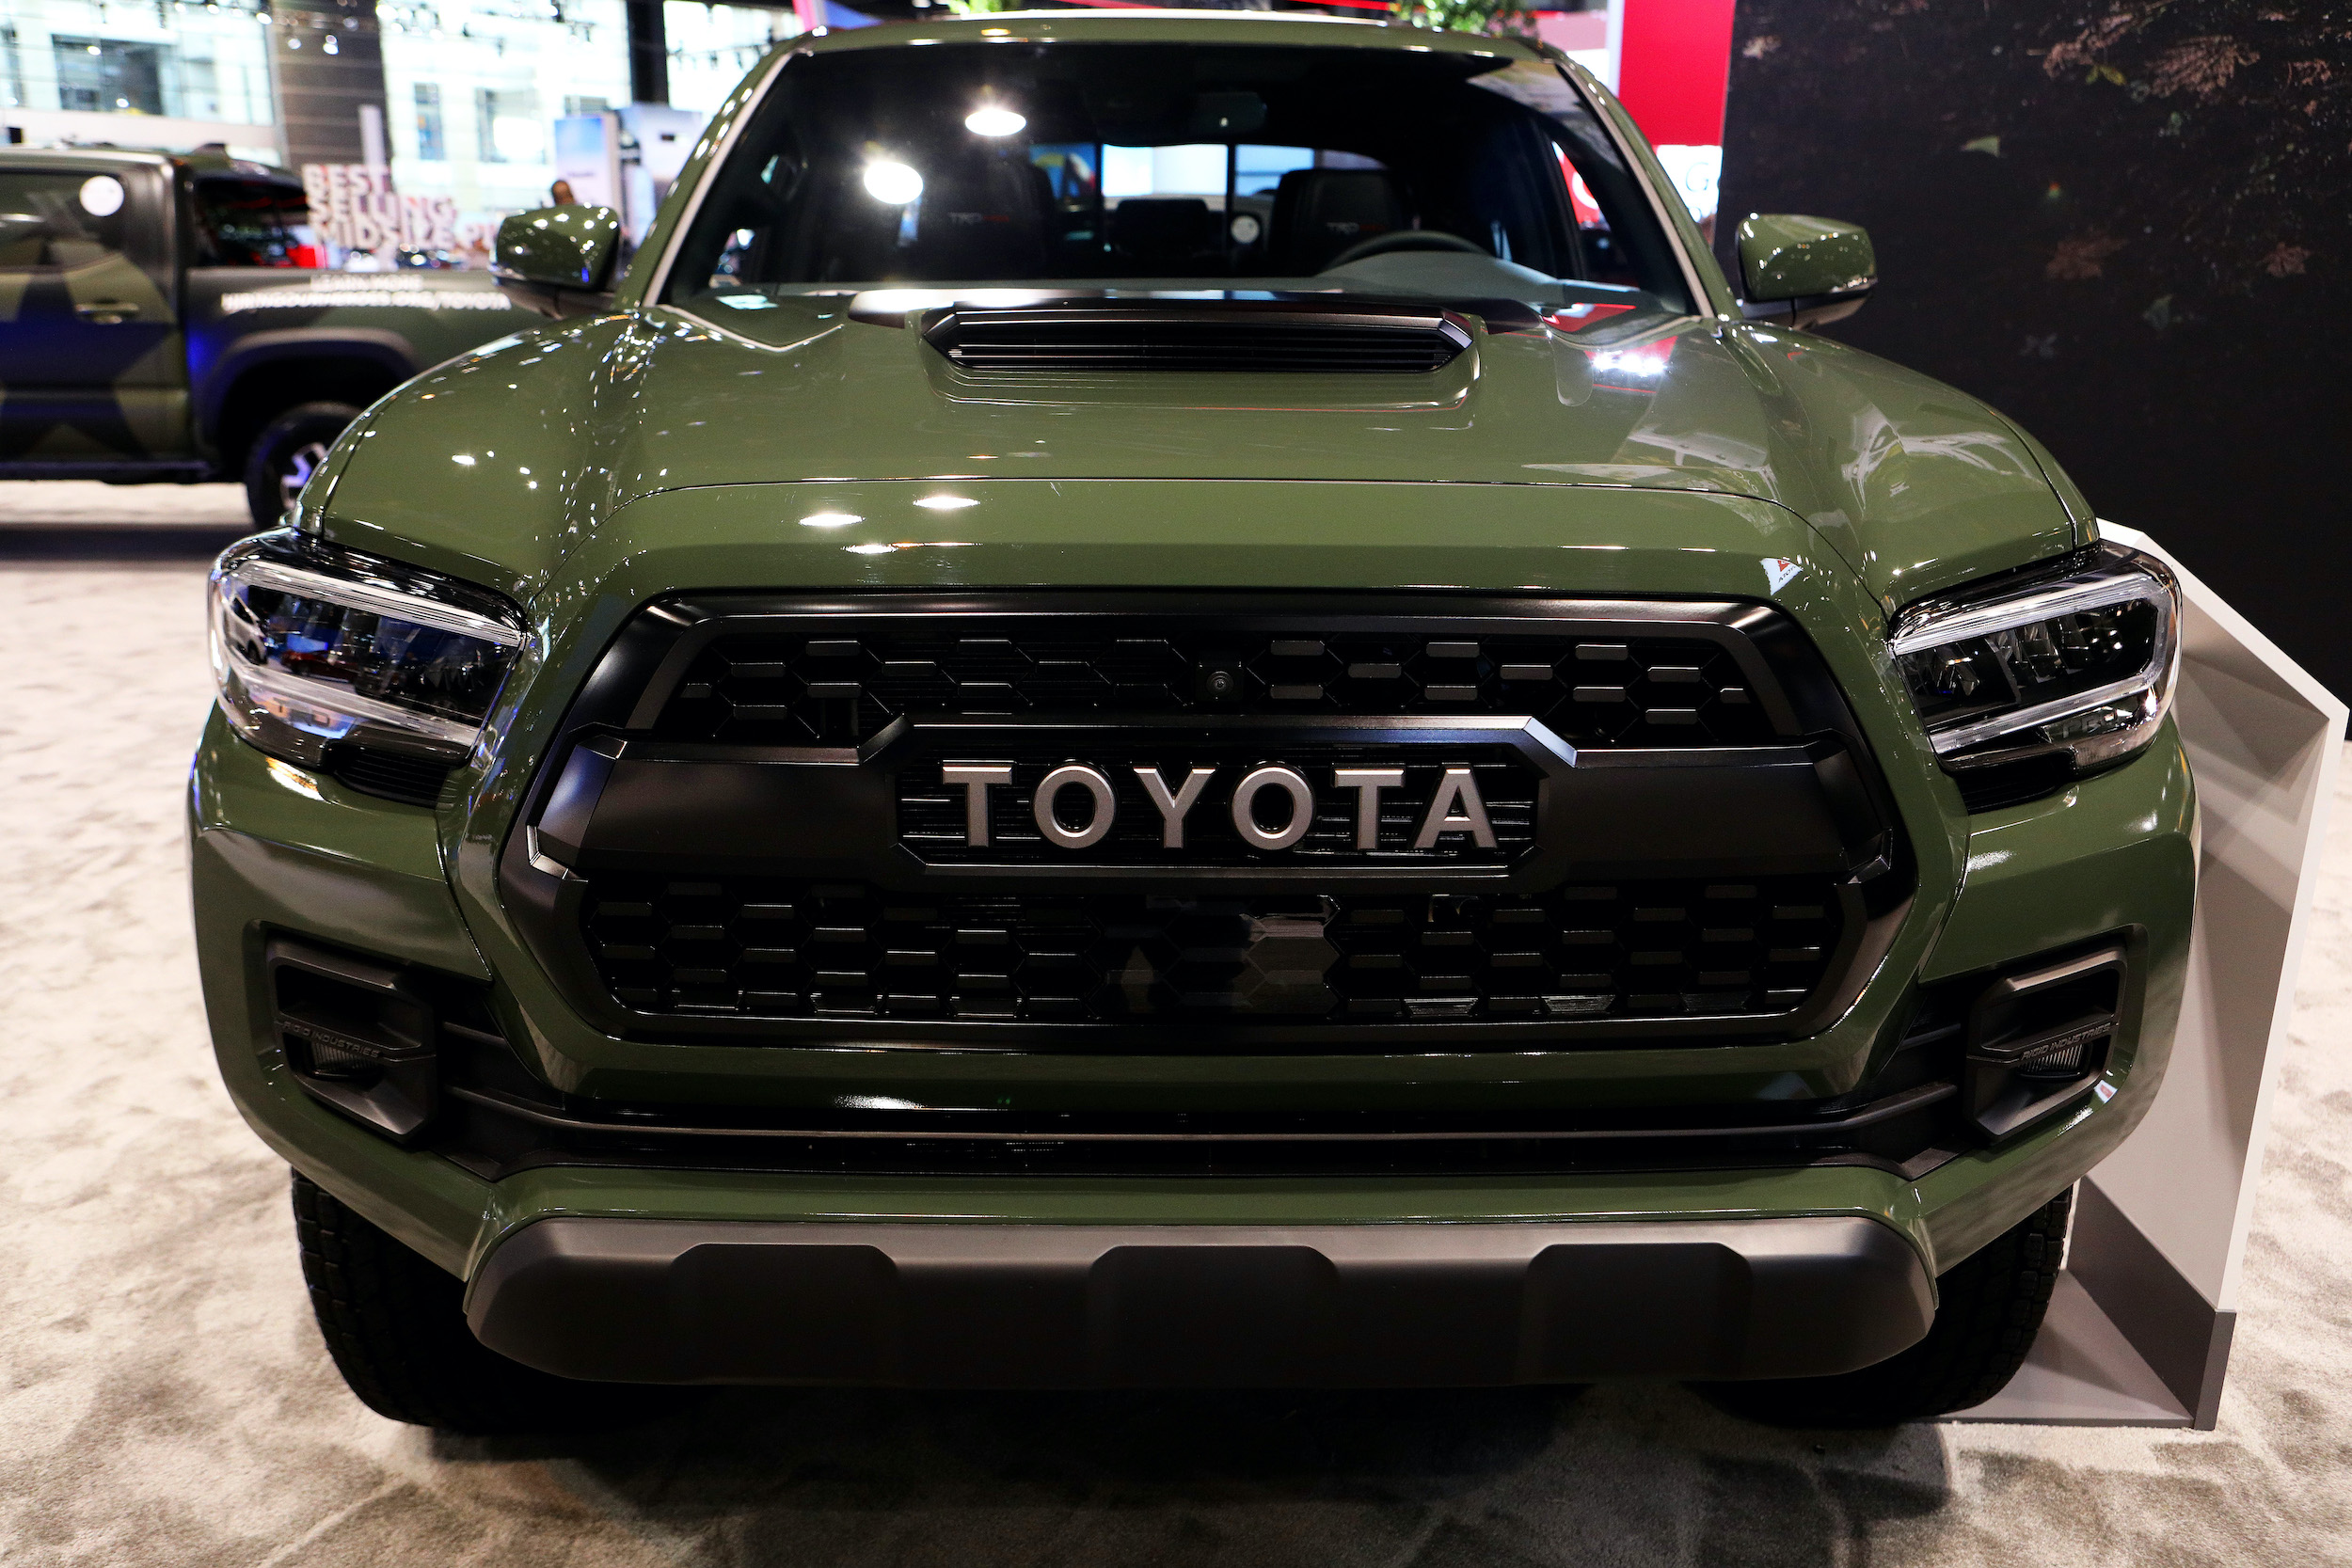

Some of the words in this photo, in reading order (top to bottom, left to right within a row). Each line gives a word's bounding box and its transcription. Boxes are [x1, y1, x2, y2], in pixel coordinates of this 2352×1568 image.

[303, 163, 391, 194] BEST
[308, 194, 457, 222] SELLING
[312, 219, 456, 249] MIDSIZE
[942, 758, 1499, 849] TOYOTA
[310, 1031, 381, 1058] INDUSTRIES
[2020, 1044, 2050, 1062] RIGID
[2050, 1022, 2111, 1051] INDUSTRIES
